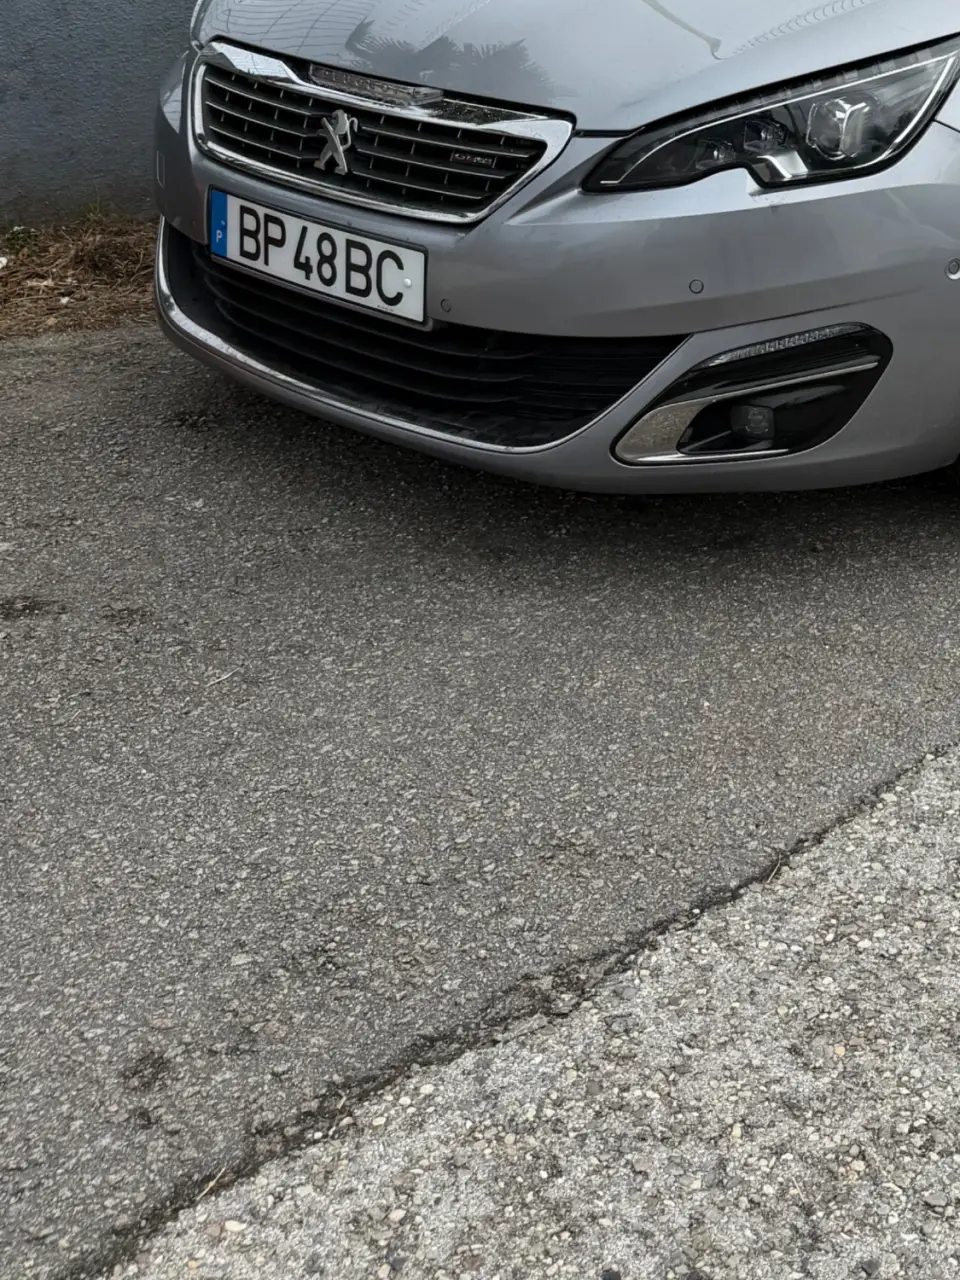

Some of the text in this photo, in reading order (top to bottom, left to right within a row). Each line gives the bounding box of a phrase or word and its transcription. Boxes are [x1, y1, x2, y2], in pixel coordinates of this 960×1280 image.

[215, 229, 223, 243] P
[240, 204, 404, 307] BP 48 BC
